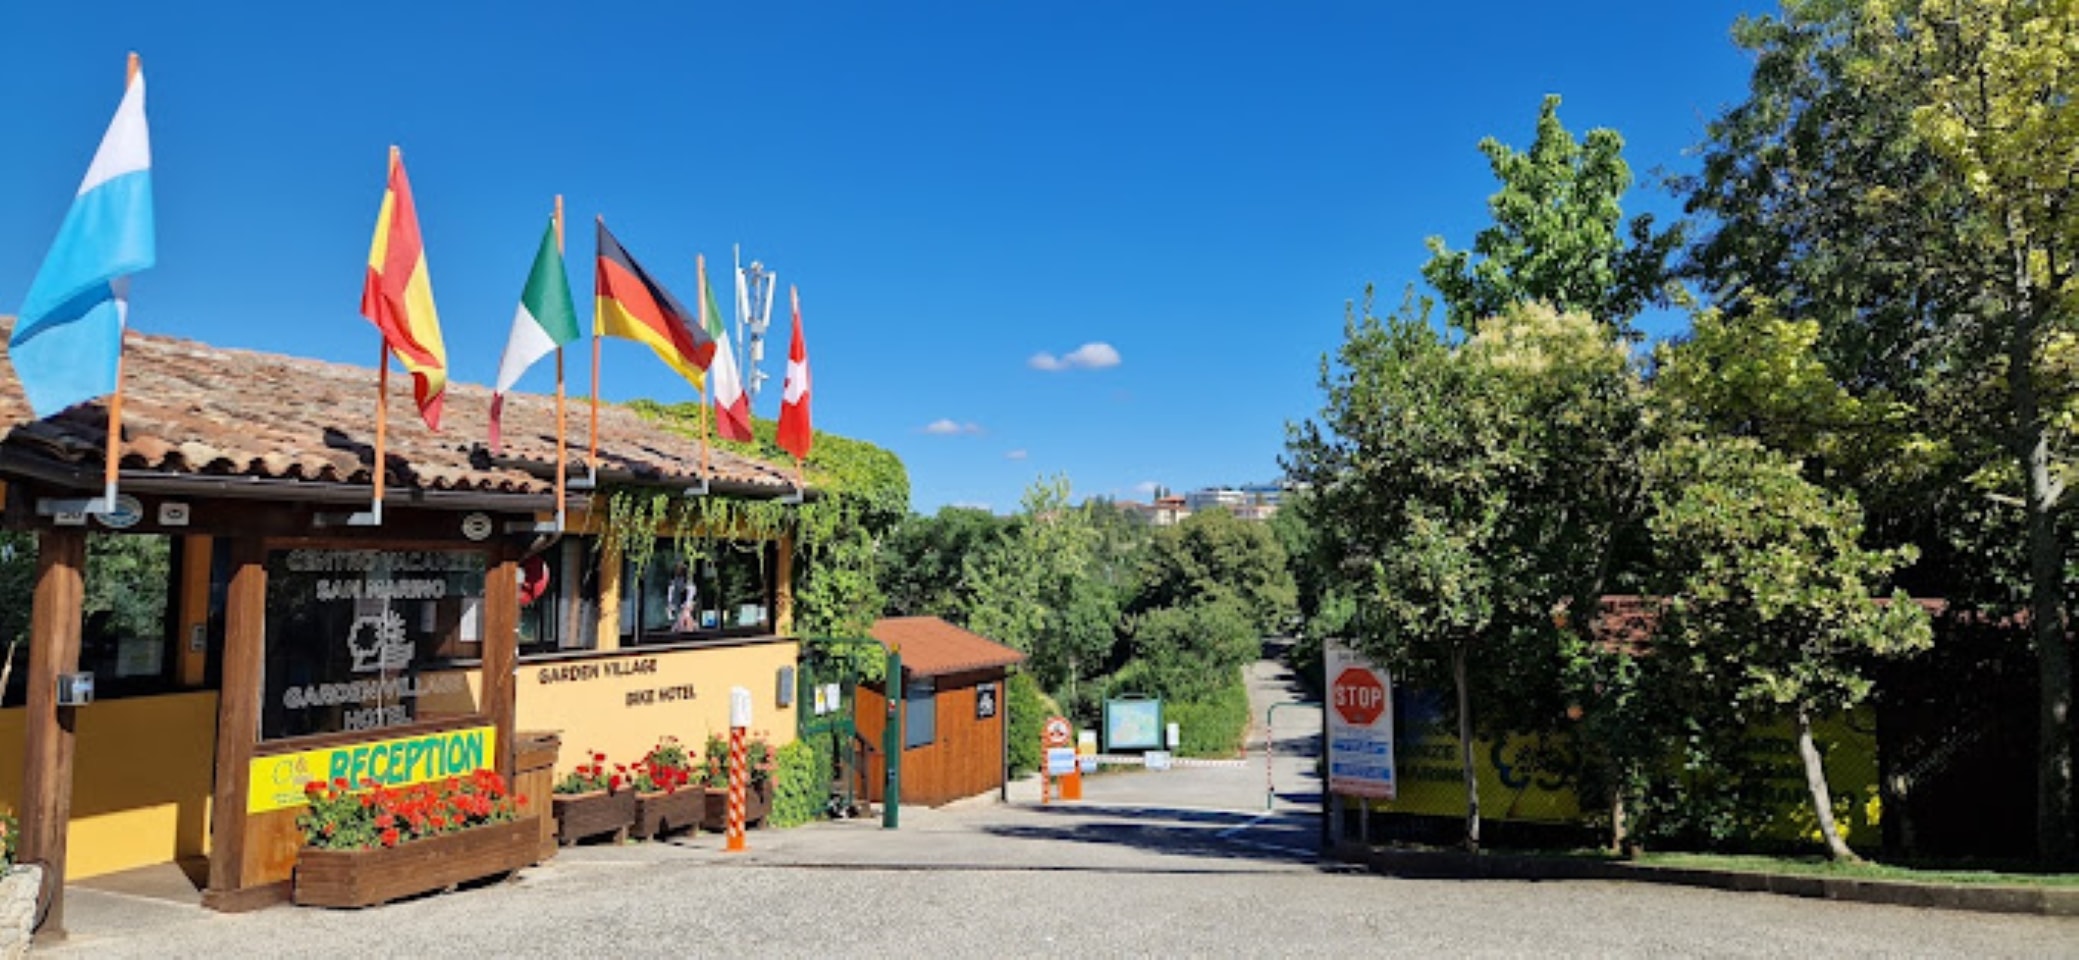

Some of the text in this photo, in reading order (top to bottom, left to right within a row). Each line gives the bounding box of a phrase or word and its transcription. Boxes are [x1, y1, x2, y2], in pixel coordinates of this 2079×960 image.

[316, 578, 446, 600] SAN MARINO
[538, 659, 657, 685] GARDEN VILLAGE
[283, 679, 379, 709] GARDEN
[625, 685, 696, 706] BIKE HOTEL
[1336, 686, 1382, 708] STOP
[343, 704, 412, 731] HOTEL
[328, 732, 484, 791] RECEPTION
